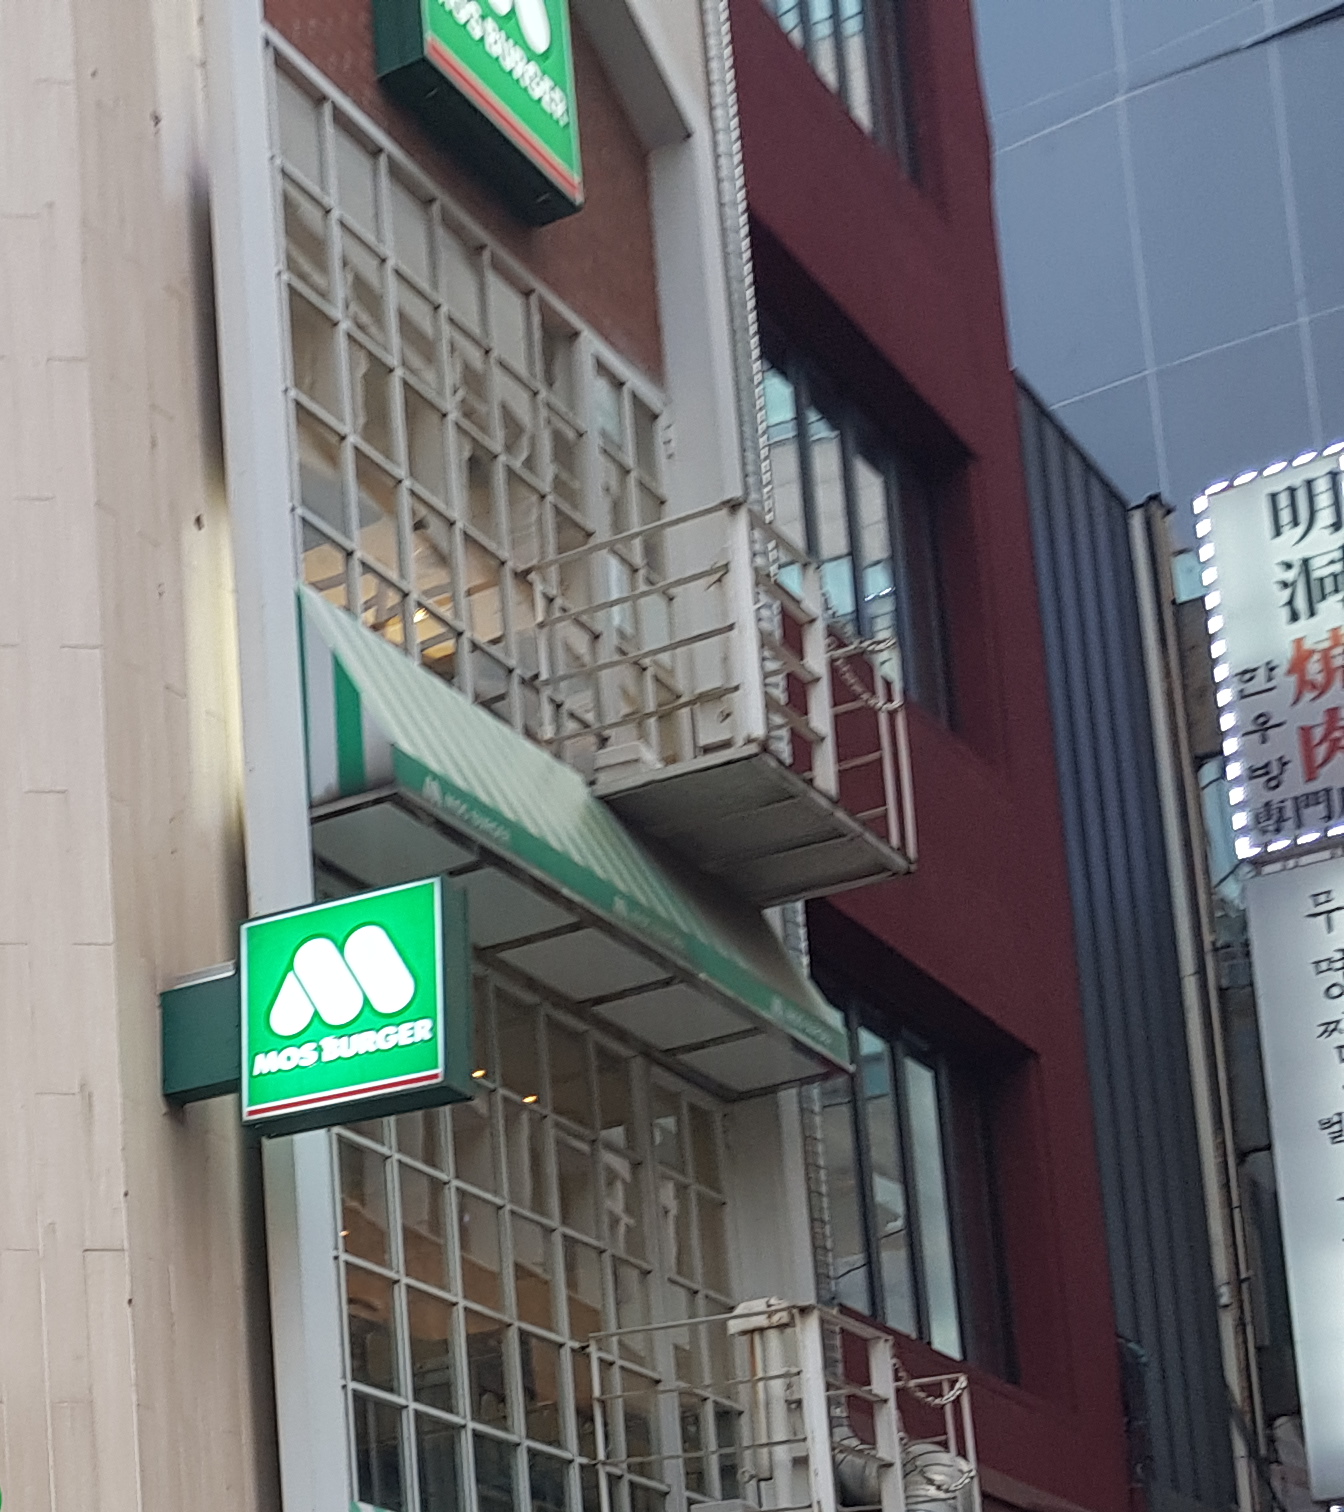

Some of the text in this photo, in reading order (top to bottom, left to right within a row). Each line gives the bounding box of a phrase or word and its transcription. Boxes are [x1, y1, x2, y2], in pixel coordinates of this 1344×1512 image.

[483, 16, 569, 128] BURGER
[252, 1017, 434, 1077] MOS BURGER
